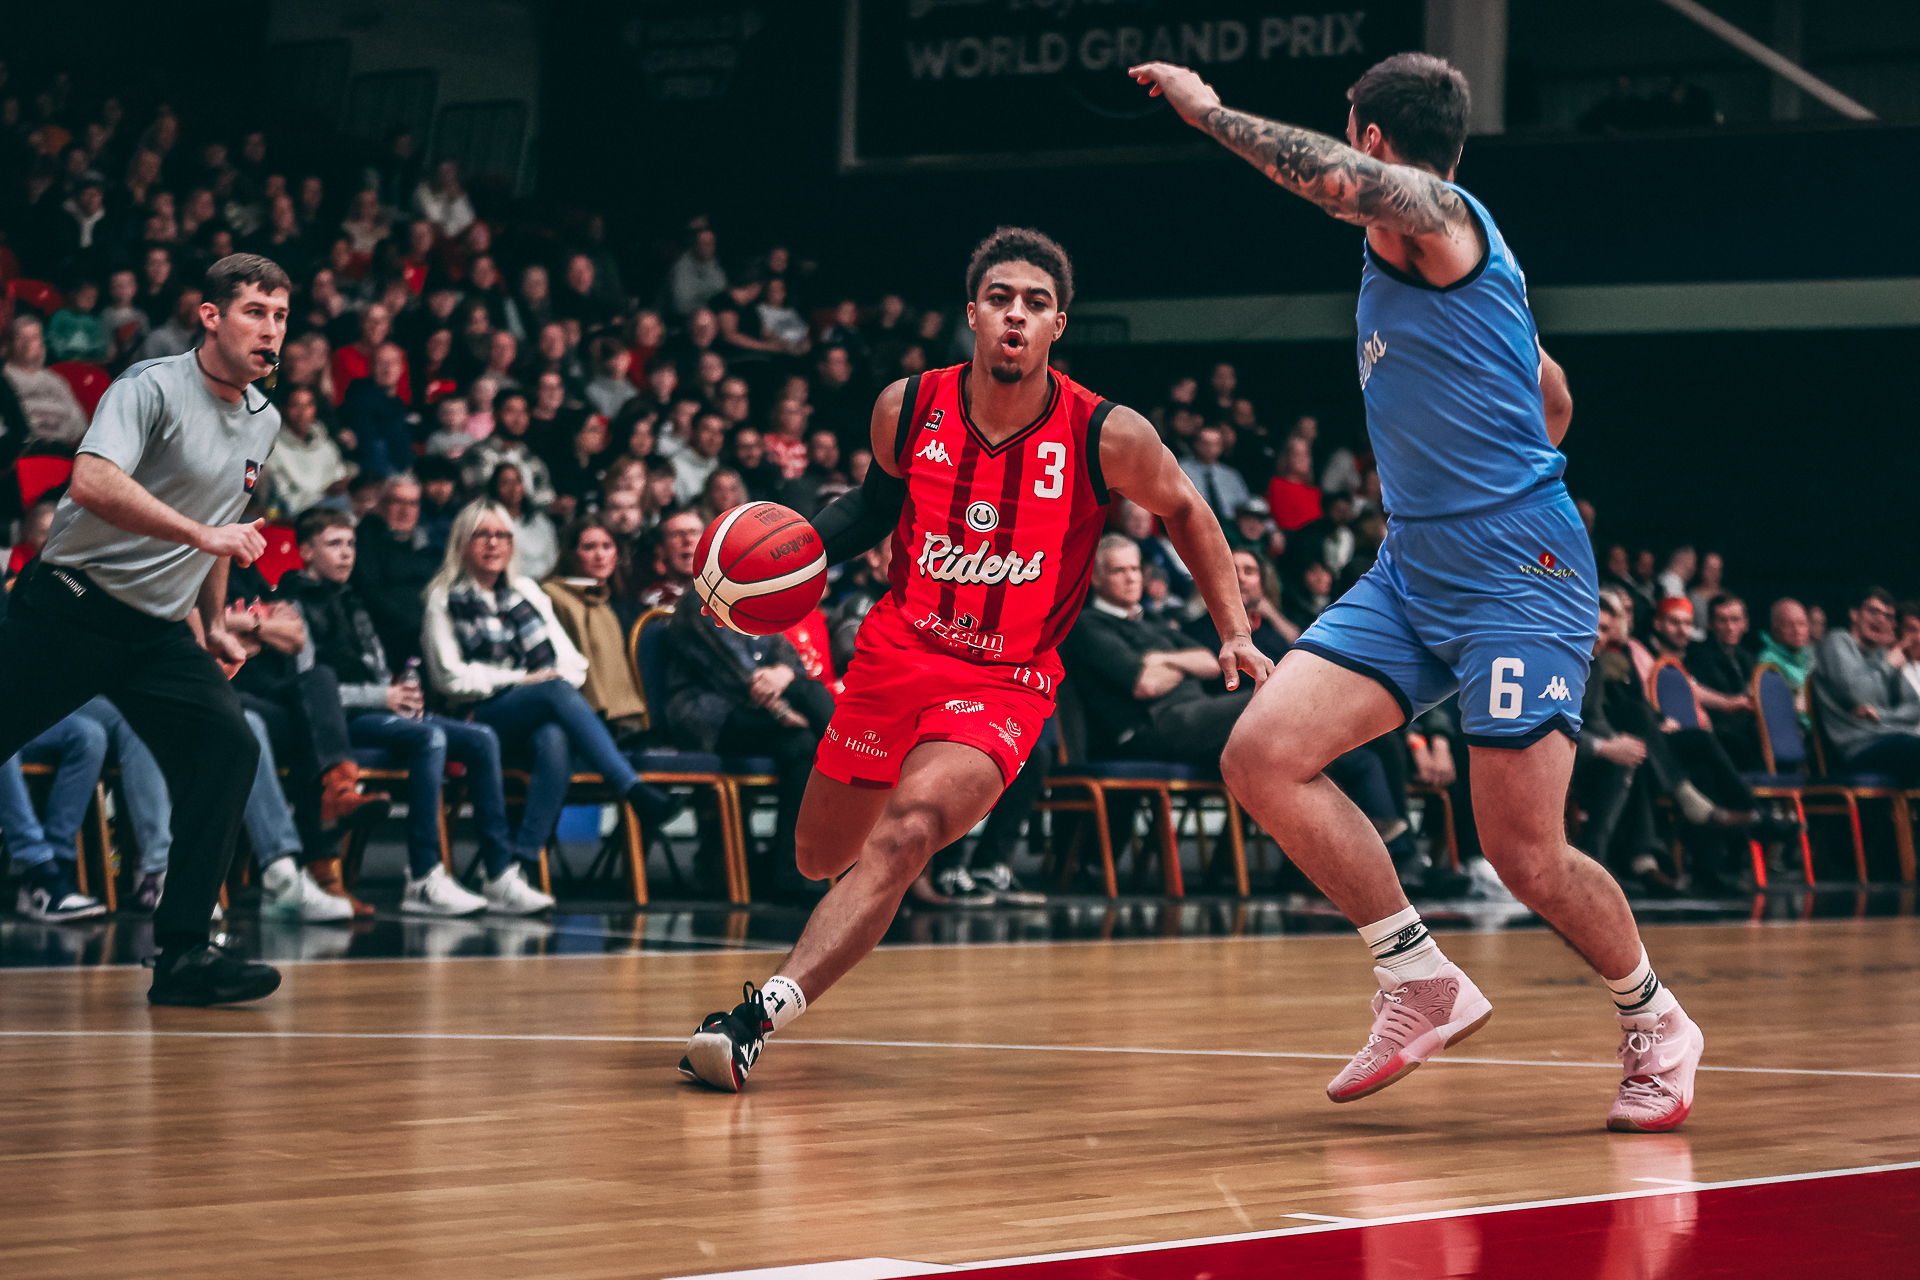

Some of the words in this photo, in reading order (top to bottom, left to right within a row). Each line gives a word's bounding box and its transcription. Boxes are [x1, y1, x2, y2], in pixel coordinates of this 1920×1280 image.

[905, 31, 1069, 80] WORLD
[1077, 20, 1250, 71] GRAND
[1257, 10, 1367, 60] PRIX
[1033, 441, 1067, 499] 3
[770, 532, 814, 560] molten
[917, 532, 1044, 586] Riders
[1489, 657, 1525, 719] 6
[845, 737, 888, 758] Hilton
[1398, 924, 1417, 944] NIKE
